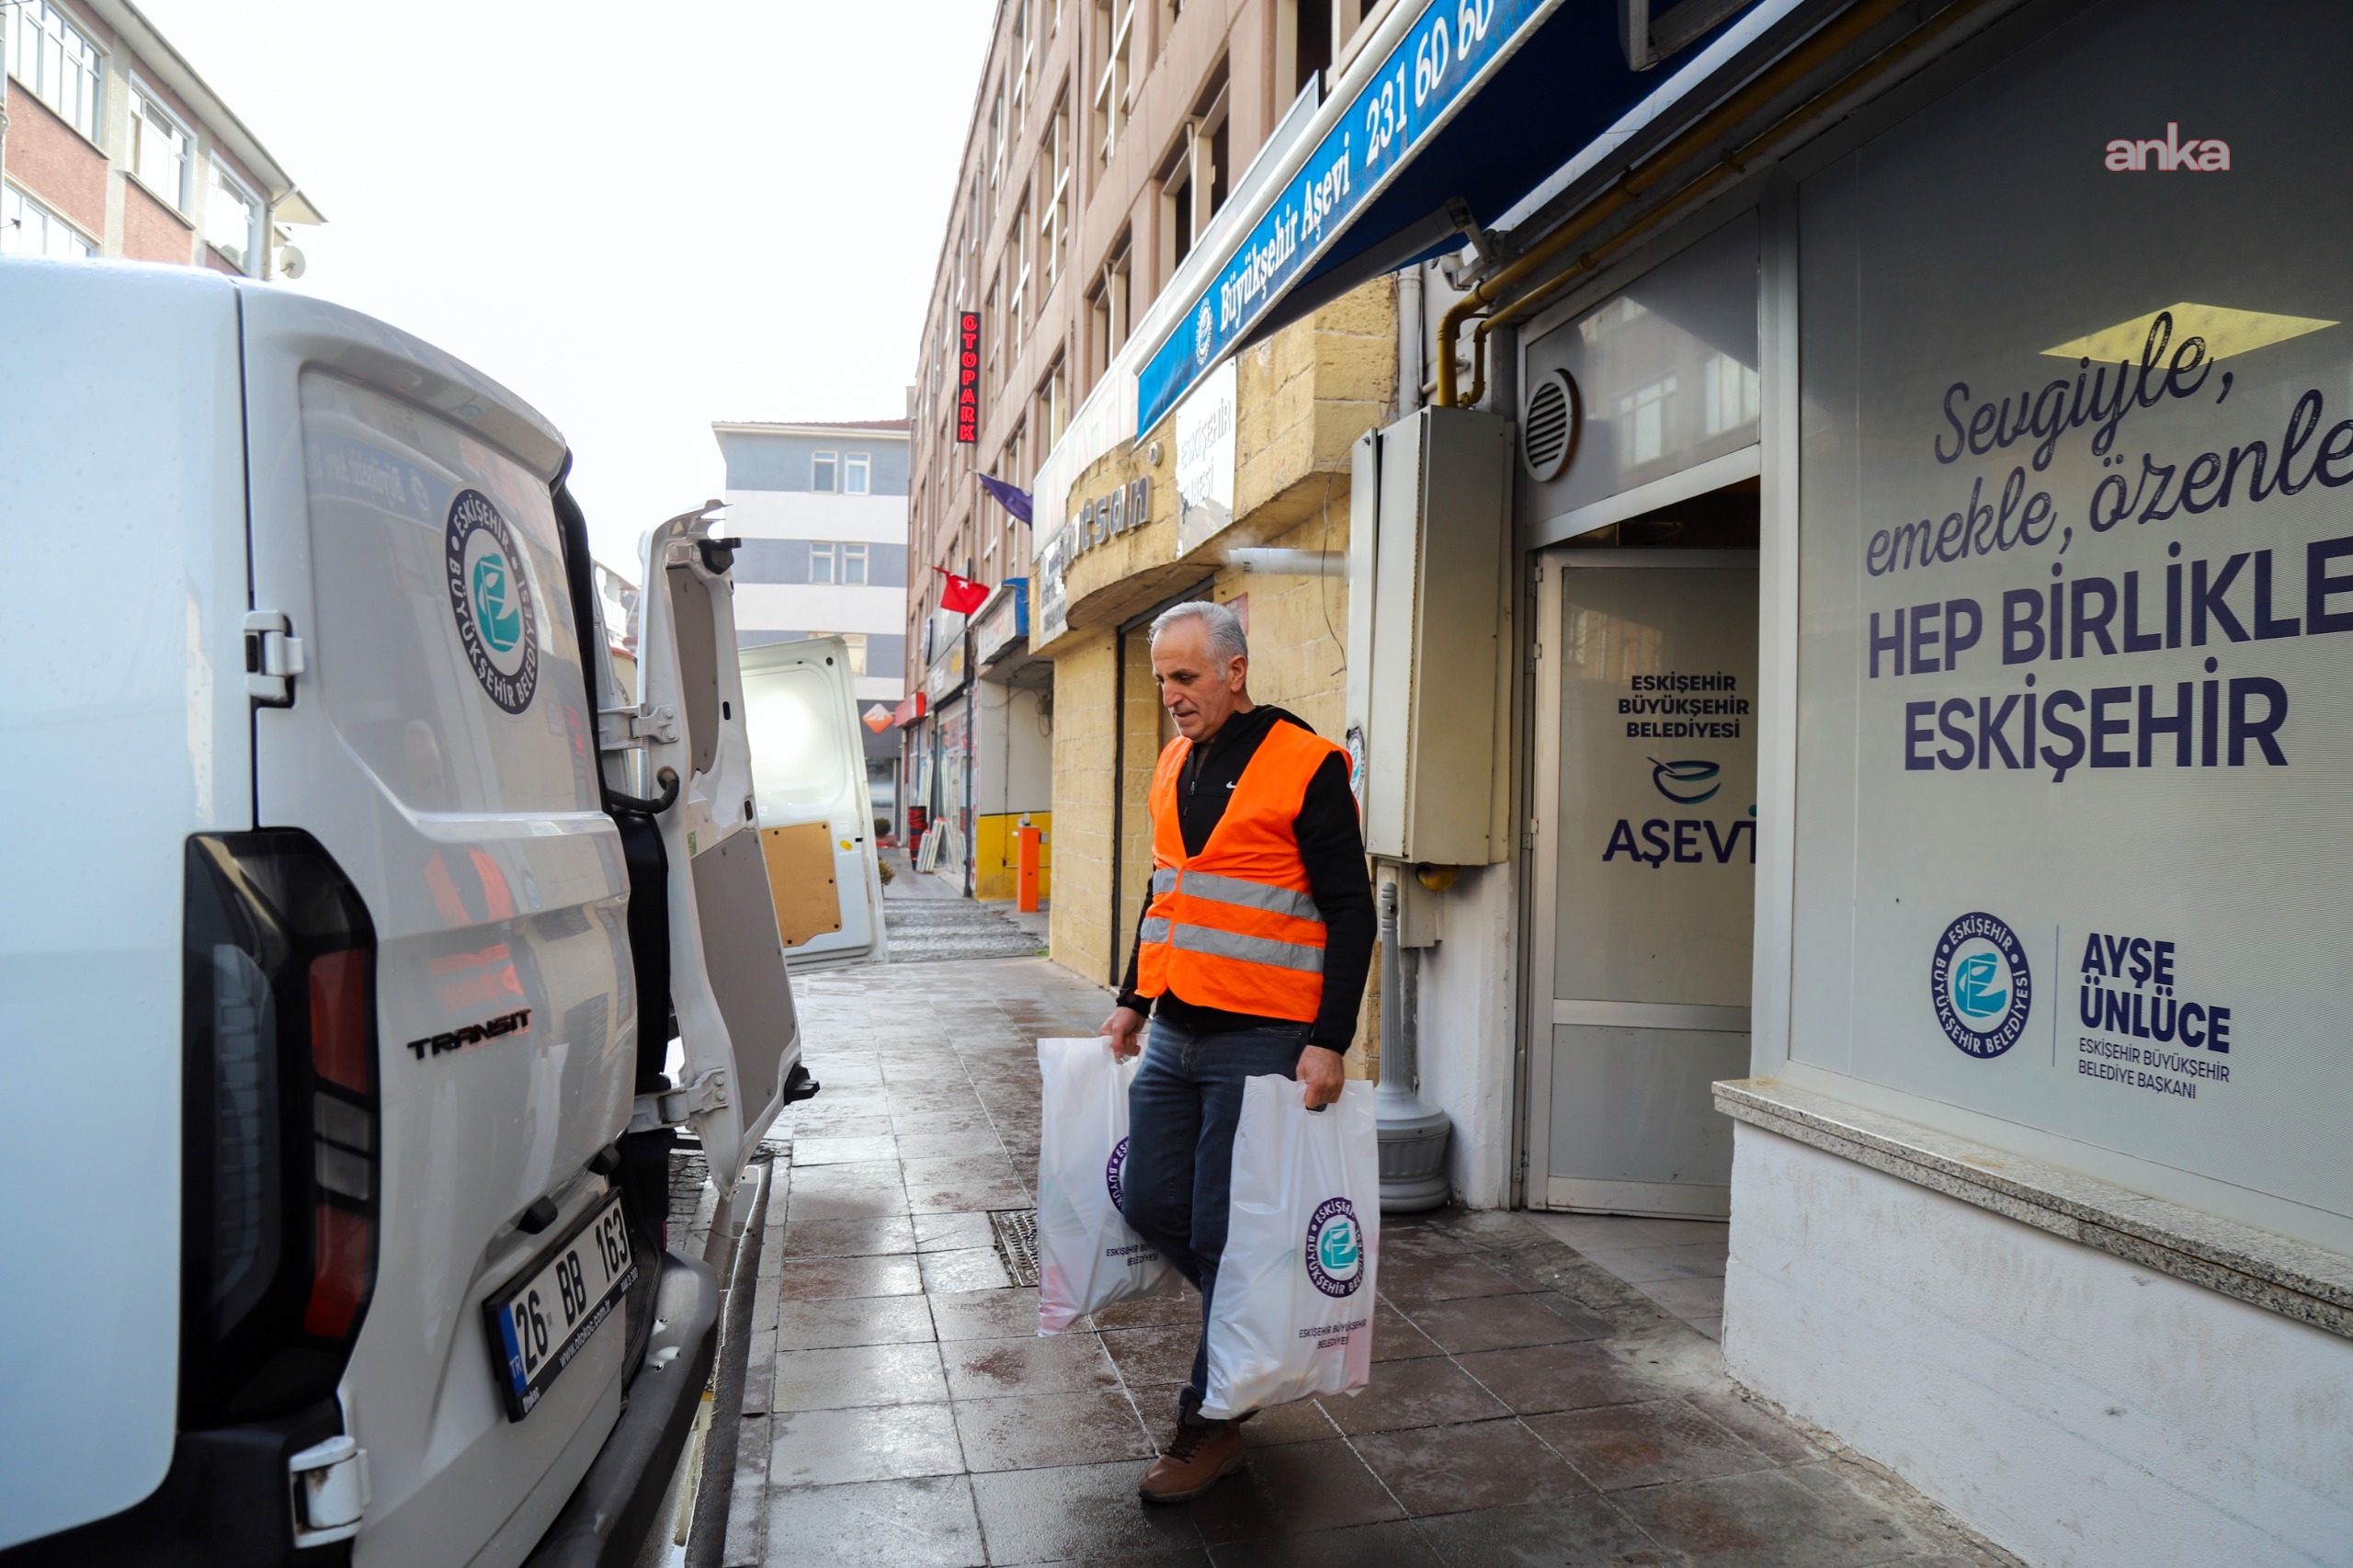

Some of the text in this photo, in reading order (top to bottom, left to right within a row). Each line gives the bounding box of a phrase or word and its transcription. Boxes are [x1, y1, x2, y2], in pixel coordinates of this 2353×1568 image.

[1220, 203, 1297, 333] Büyükşehir
[1301, 131, 1351, 241] Aşevi
[1366, 61, 1407, 167] 231
[1415, 16, 1449, 108] 60
[959, 313, 979, 442] OTOPARK
[1935, 311, 2234, 472] Sevgiyle,
[1180, 397, 1232, 472] ESKİŞEHİR
[1866, 389, 2353, 577] emekle, özenle
[453, 494, 511, 551] ESKİŞEHİR
[449, 556, 537, 707] BÜYÜKŞEHİR BELEDİYESİ
[1869, 536, 2353, 679] HEP BİRLİKLE
[1618, 694, 1750, 717] BÜYÜKŞEHİR
[1631, 671, 1737, 694] ESKİŞEHİR
[1904, 656, 2289, 783] ESKİŞEHİR
[1626, 718, 1741, 739] BELEDİYESİ
[1948, 915, 2013, 952] ESKİŞEHİR
[2080, 933, 2176, 990] AYŞE
[406, 1007, 532, 1061] TRANSIT
[1933, 958, 2029, 1055] BÜYÜKŞEHİR BELEDİYESİ
[2079, 974, 2231, 1054] ÜNLÜCE
[2077, 1058, 2197, 1100] BELEDİYE BAŞKANI
[2078, 1036, 2231, 1083] ESKİŞEHİR BÜYÜKŞEHİR
[516, 1207, 628, 1375] 26 BB 163
[509, 1355, 523, 1380] TR
